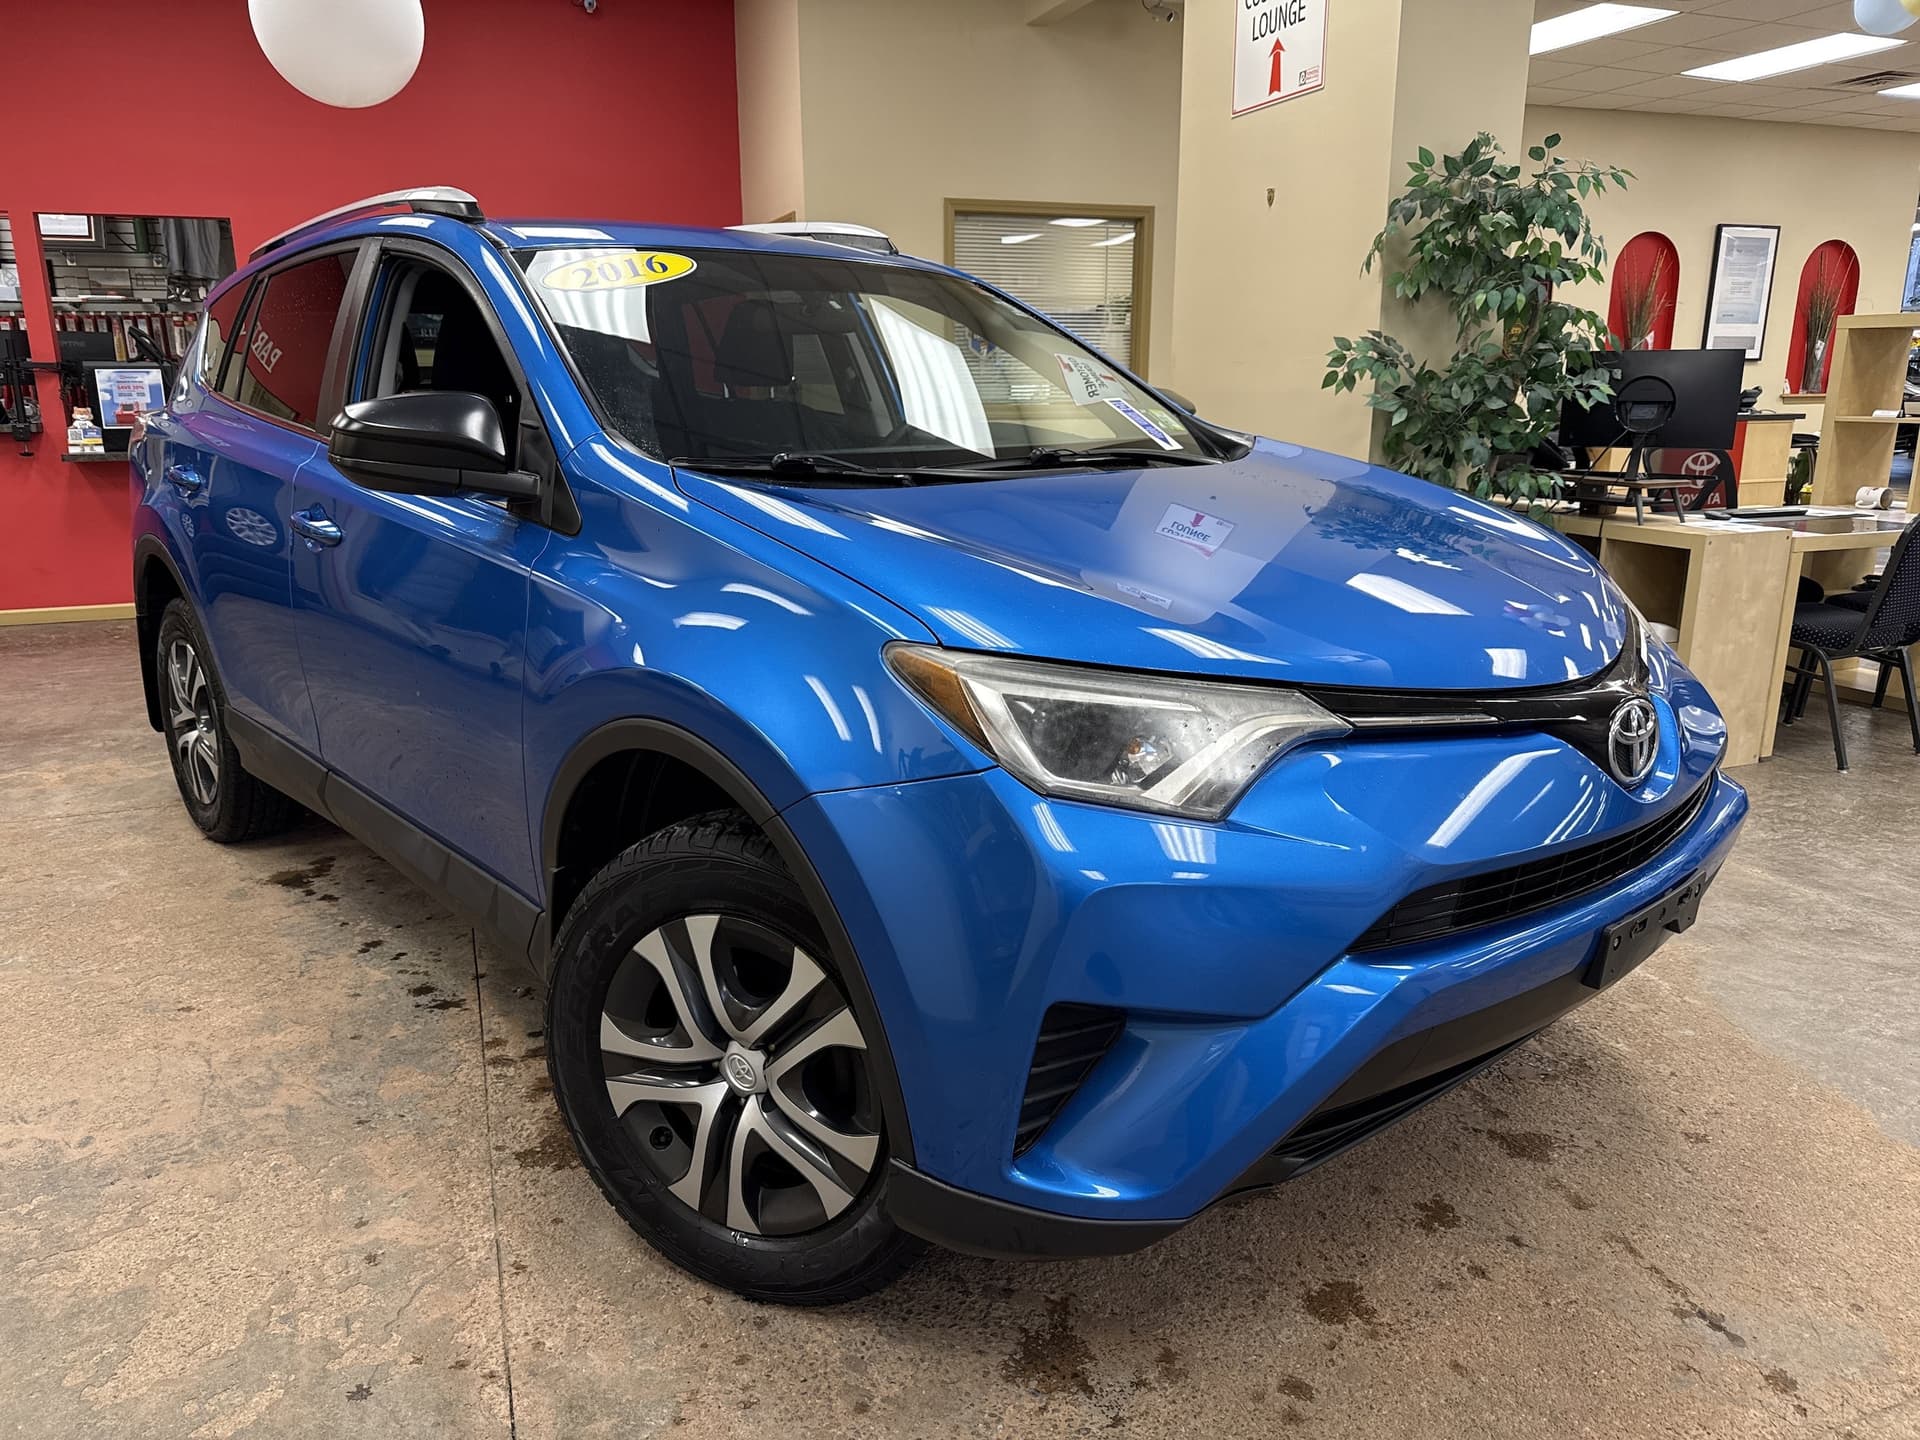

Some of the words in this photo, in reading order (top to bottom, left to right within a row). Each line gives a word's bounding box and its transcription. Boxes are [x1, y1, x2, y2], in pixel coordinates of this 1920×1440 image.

[1252, 0, 1306, 41] LOUNGE
[572, 254, 669, 288] 2016
[1680, 492, 1721, 506] OYTA
